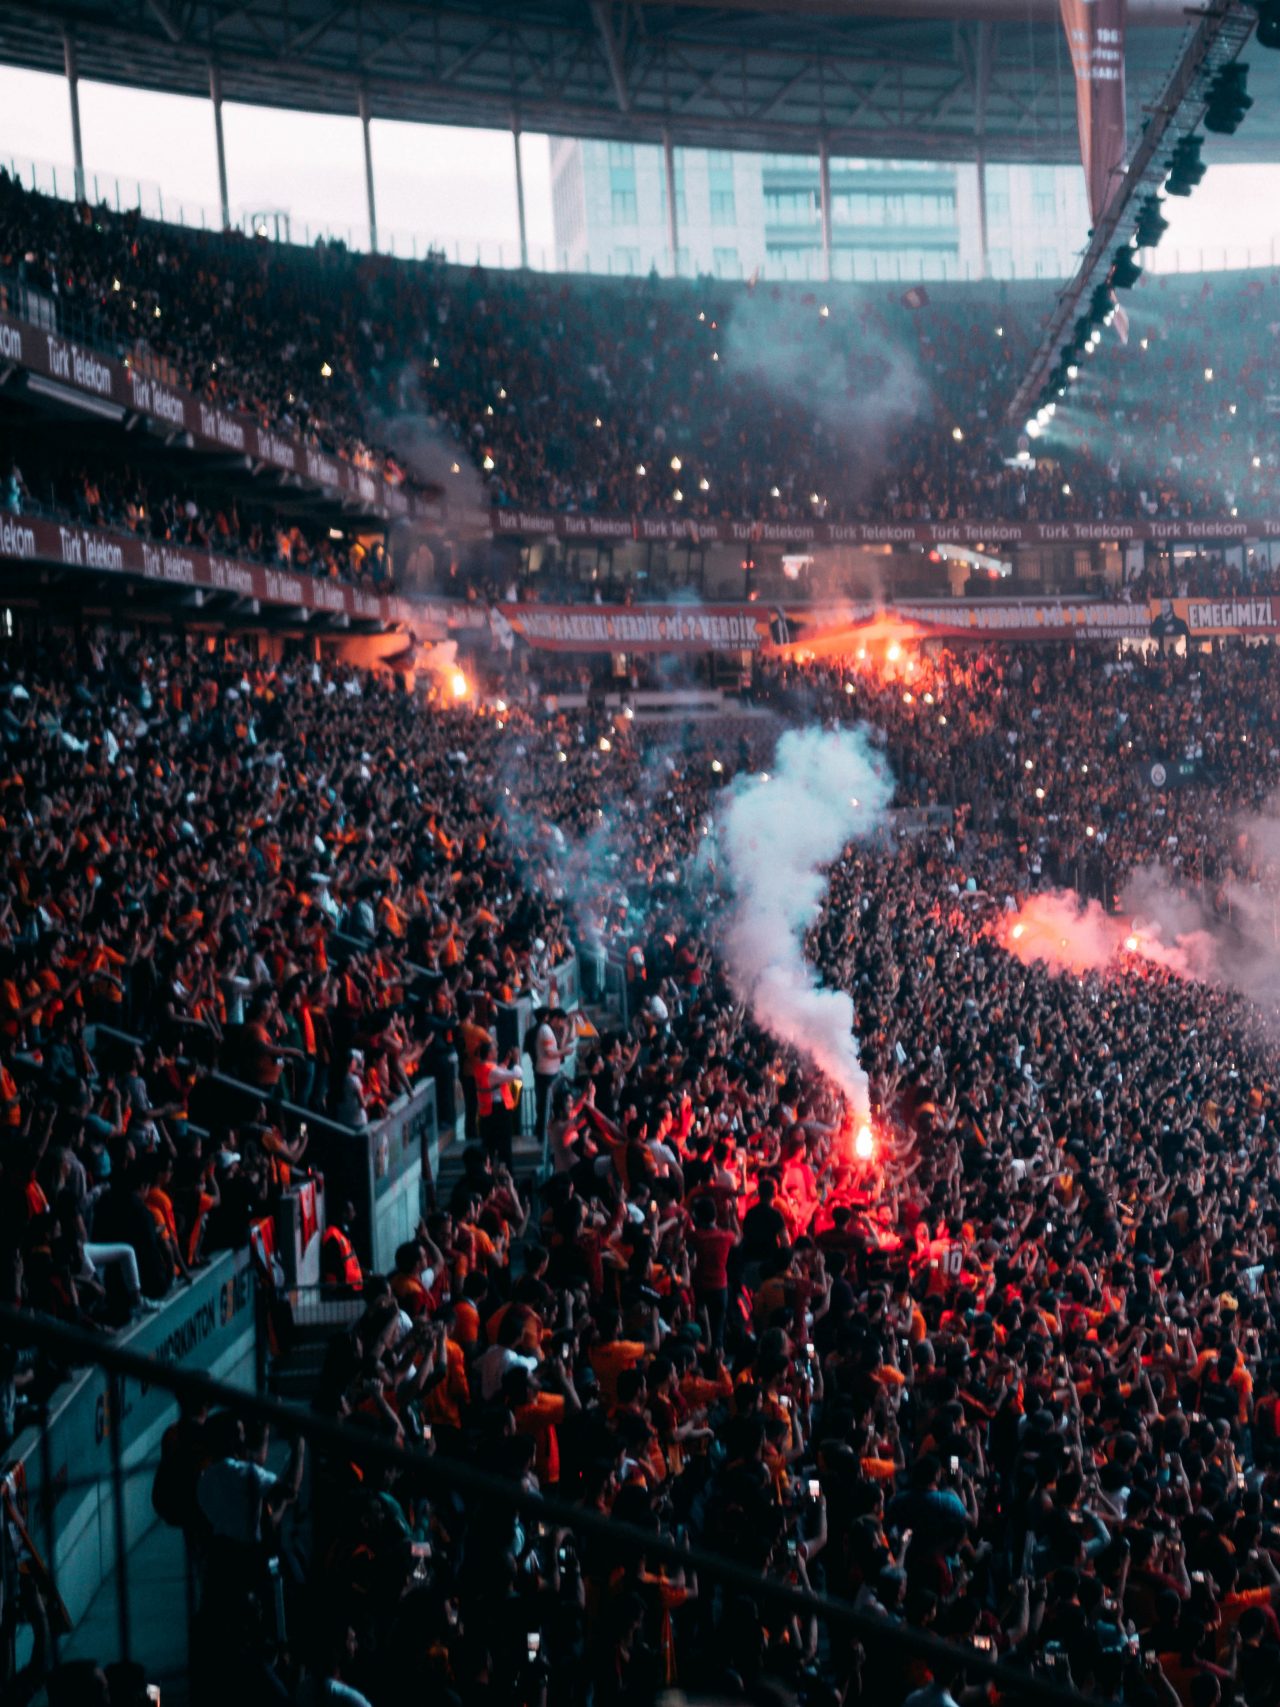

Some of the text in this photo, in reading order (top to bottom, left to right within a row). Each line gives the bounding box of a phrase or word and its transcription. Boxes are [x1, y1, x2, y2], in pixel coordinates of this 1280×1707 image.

[71, 346, 112, 396] Telekom
[643, 518, 669, 537] Türk
[762, 522, 815, 539] Telekom
[828, 523, 916, 540] Türk Telekom
[930, 523, 1022, 540] Türk Telekom
[1038, 522, 1134, 540] Türk Telekom
[1150, 520, 1247, 538] Türk Telekom
[59, 526, 123, 571] Türk Telekom
[611, 609, 663, 641] VERDİK
[943, 1250, 963, 1275] 10
